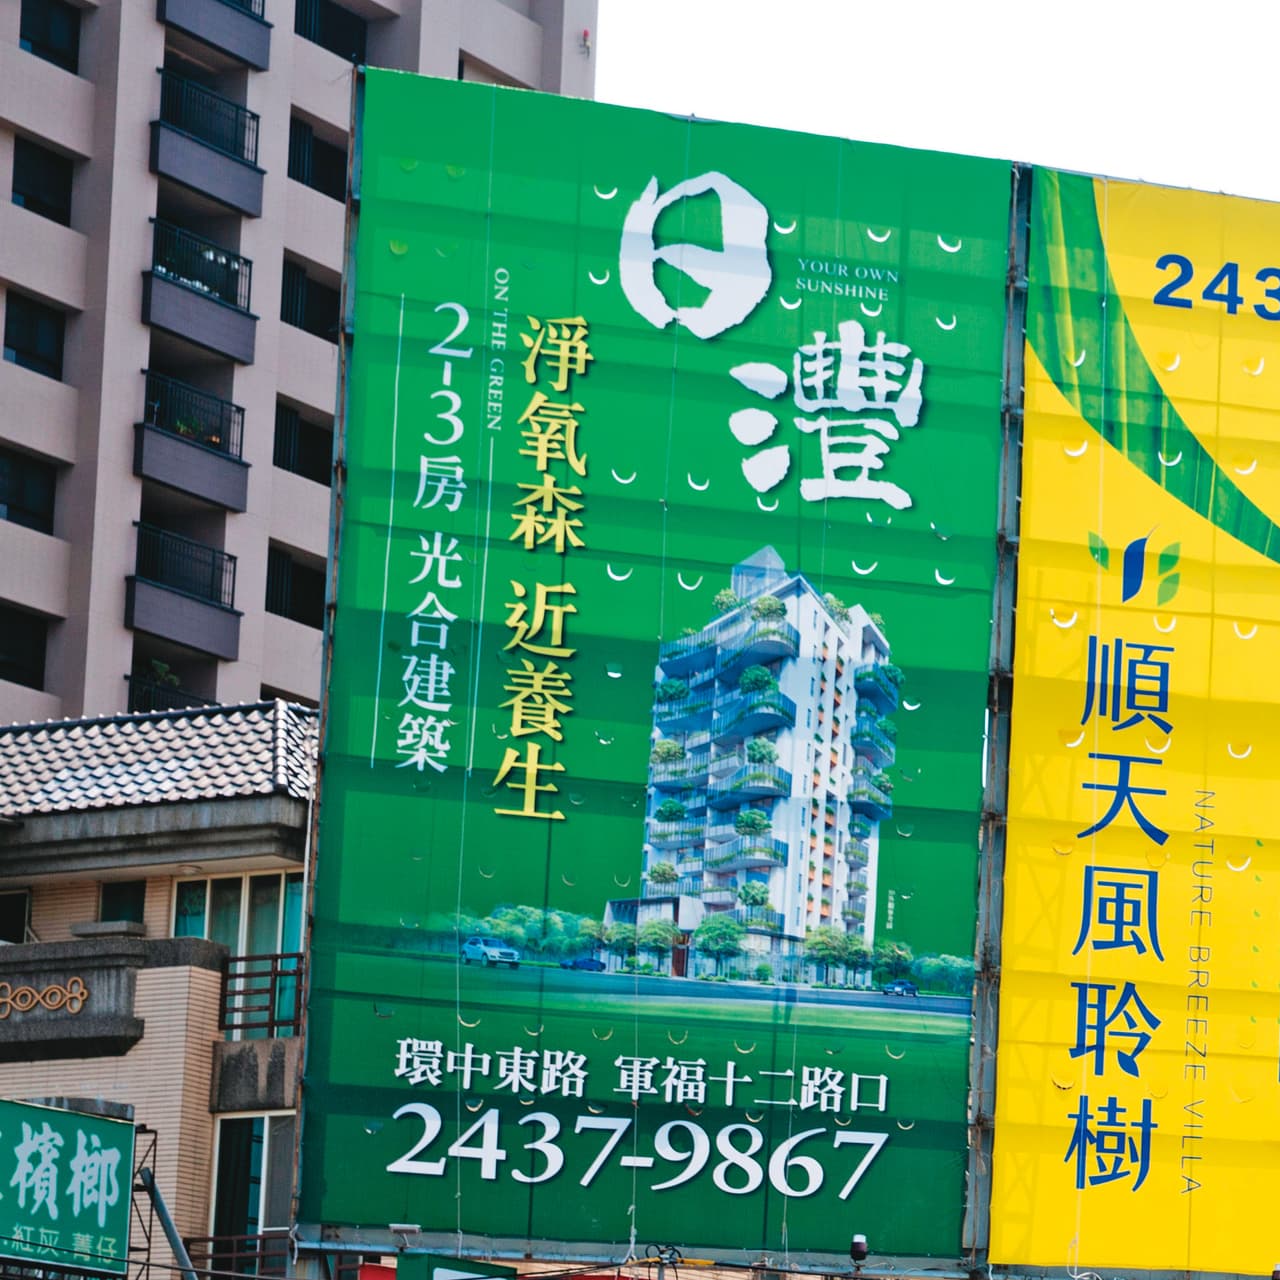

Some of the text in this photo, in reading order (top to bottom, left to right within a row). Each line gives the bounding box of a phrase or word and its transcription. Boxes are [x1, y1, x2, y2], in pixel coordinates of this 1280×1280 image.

[487, 267, 510, 430] ON THE GREEN
[796, 277, 889, 301] SUNSHINE
[798, 258, 899, 283] YOUR OWN
[395, 302, 473, 773] 2-3房 光合建築
[492, 315, 594, 821] 淨氧森 近養生
[1063, 634, 1176, 1193] 順天風聆樹
[1180, 789, 1217, 1195] NATURE BREEZE VILLA
[386, 1102, 890, 1200] 2437-9867
[394, 1036, 889, 1113] 環中東路 軍福十二路口
